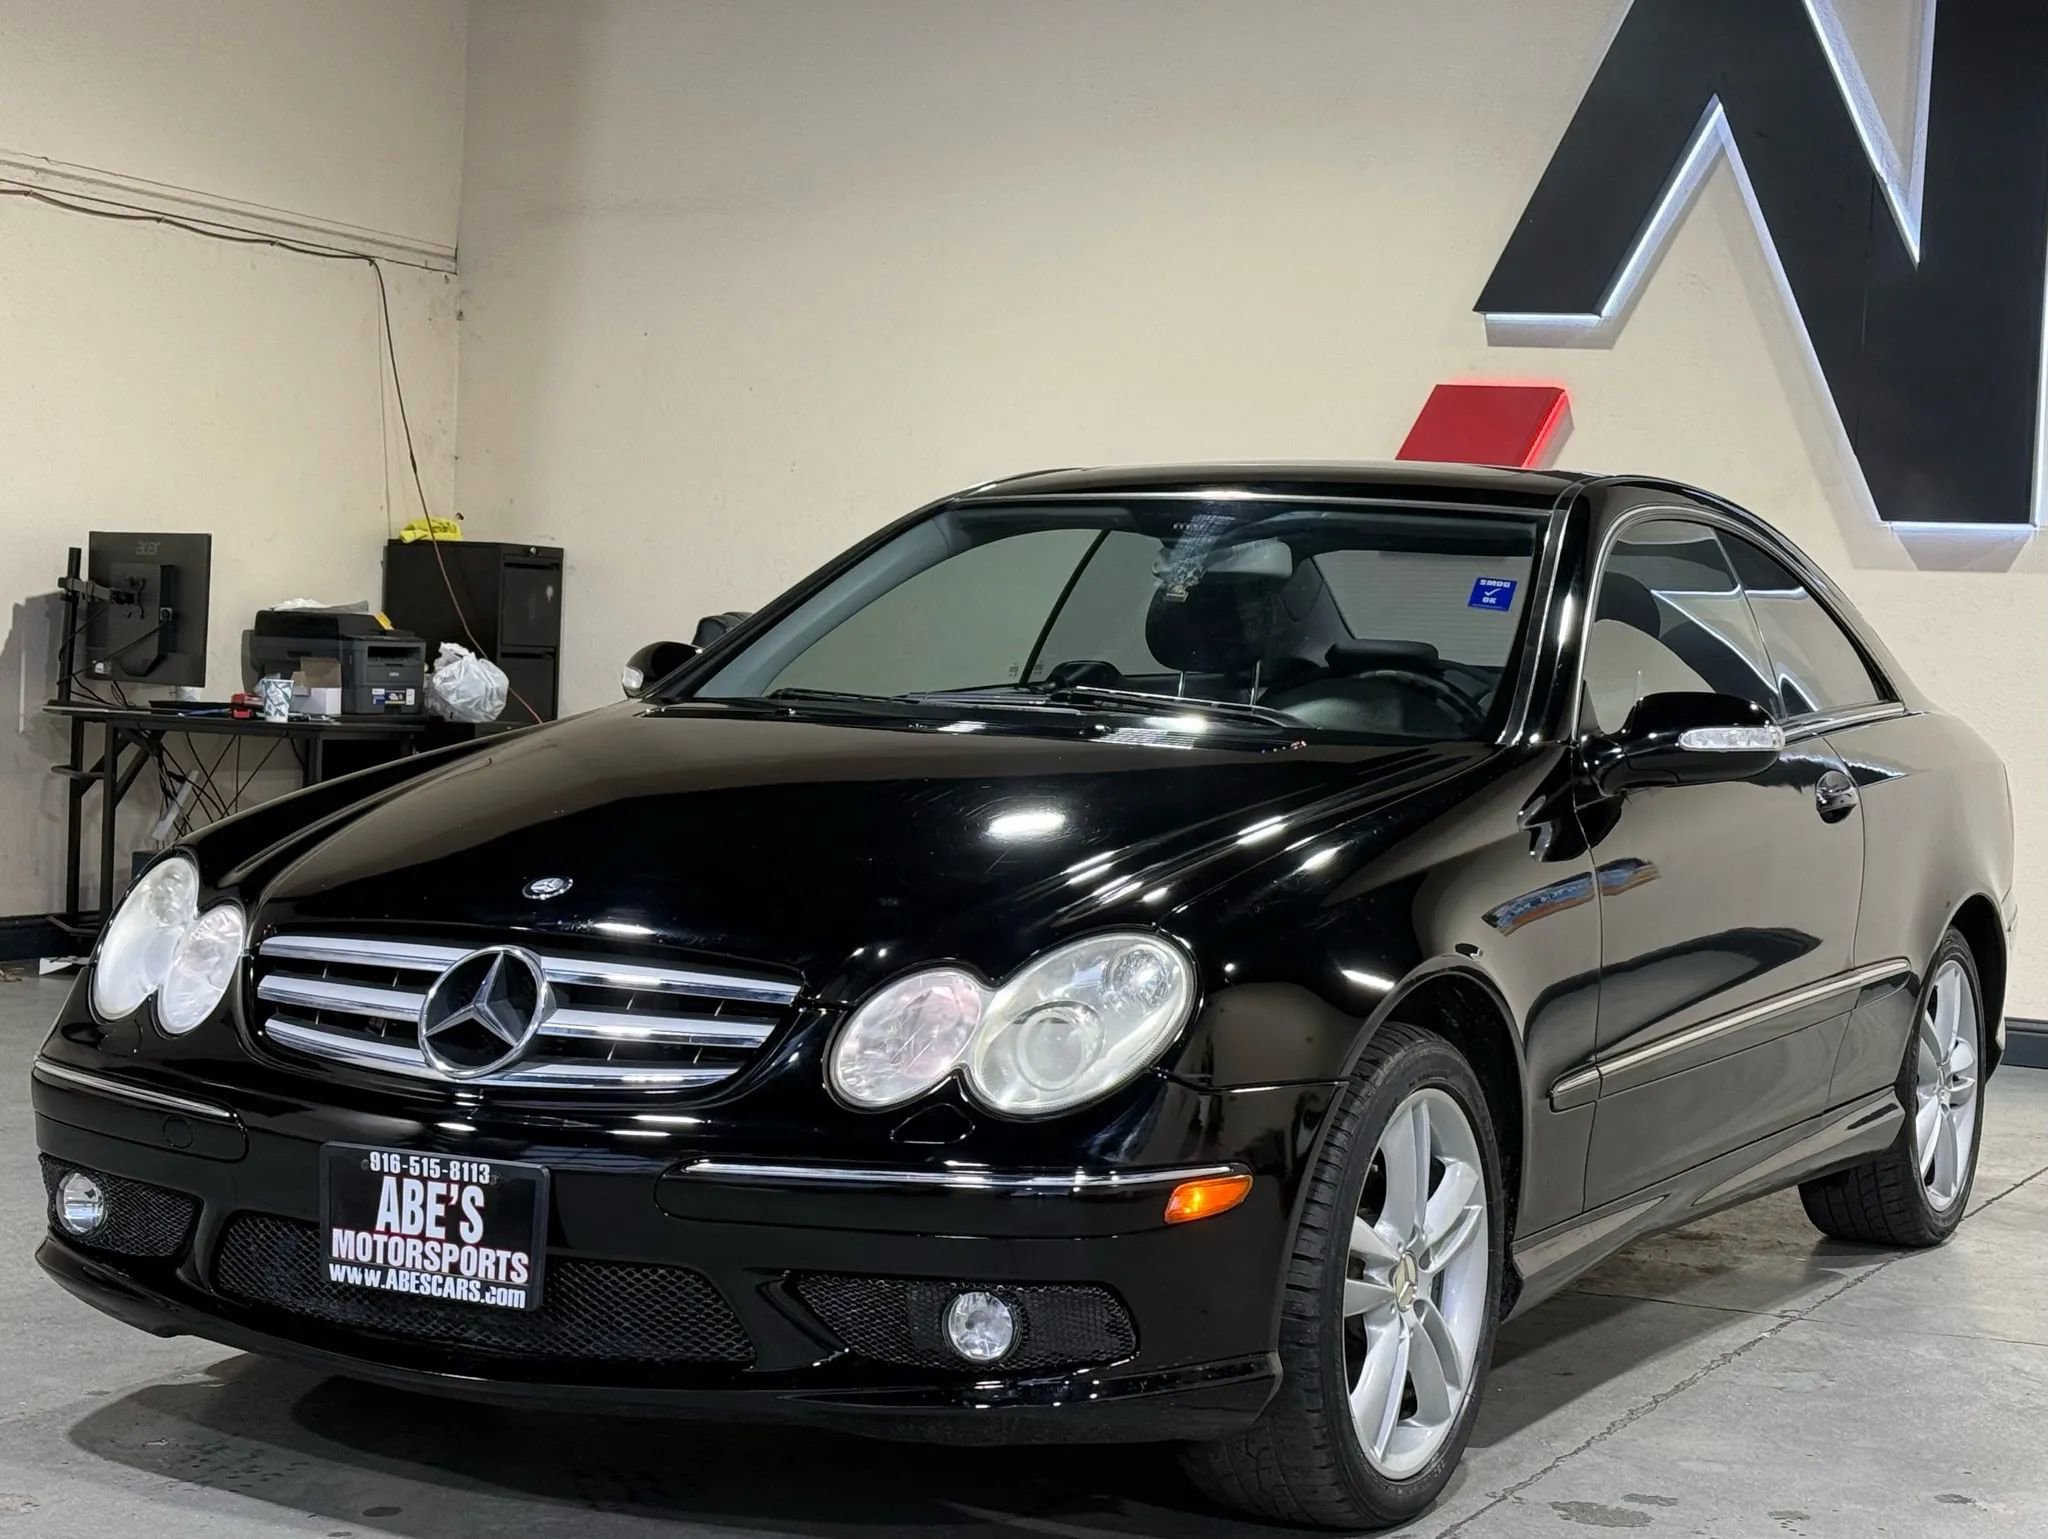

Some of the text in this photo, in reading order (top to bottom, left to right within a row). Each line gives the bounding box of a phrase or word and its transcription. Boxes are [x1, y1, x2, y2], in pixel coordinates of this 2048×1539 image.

[1480, 580, 1511, 588] SMOG
[369, 1151, 491, 1185] 916-515-8113
[375, 1175, 485, 1244] ABE'S
[332, 1227, 530, 1285] MOTORSPORTS
[329, 1263, 527, 1309] www.ABESCARS.com
